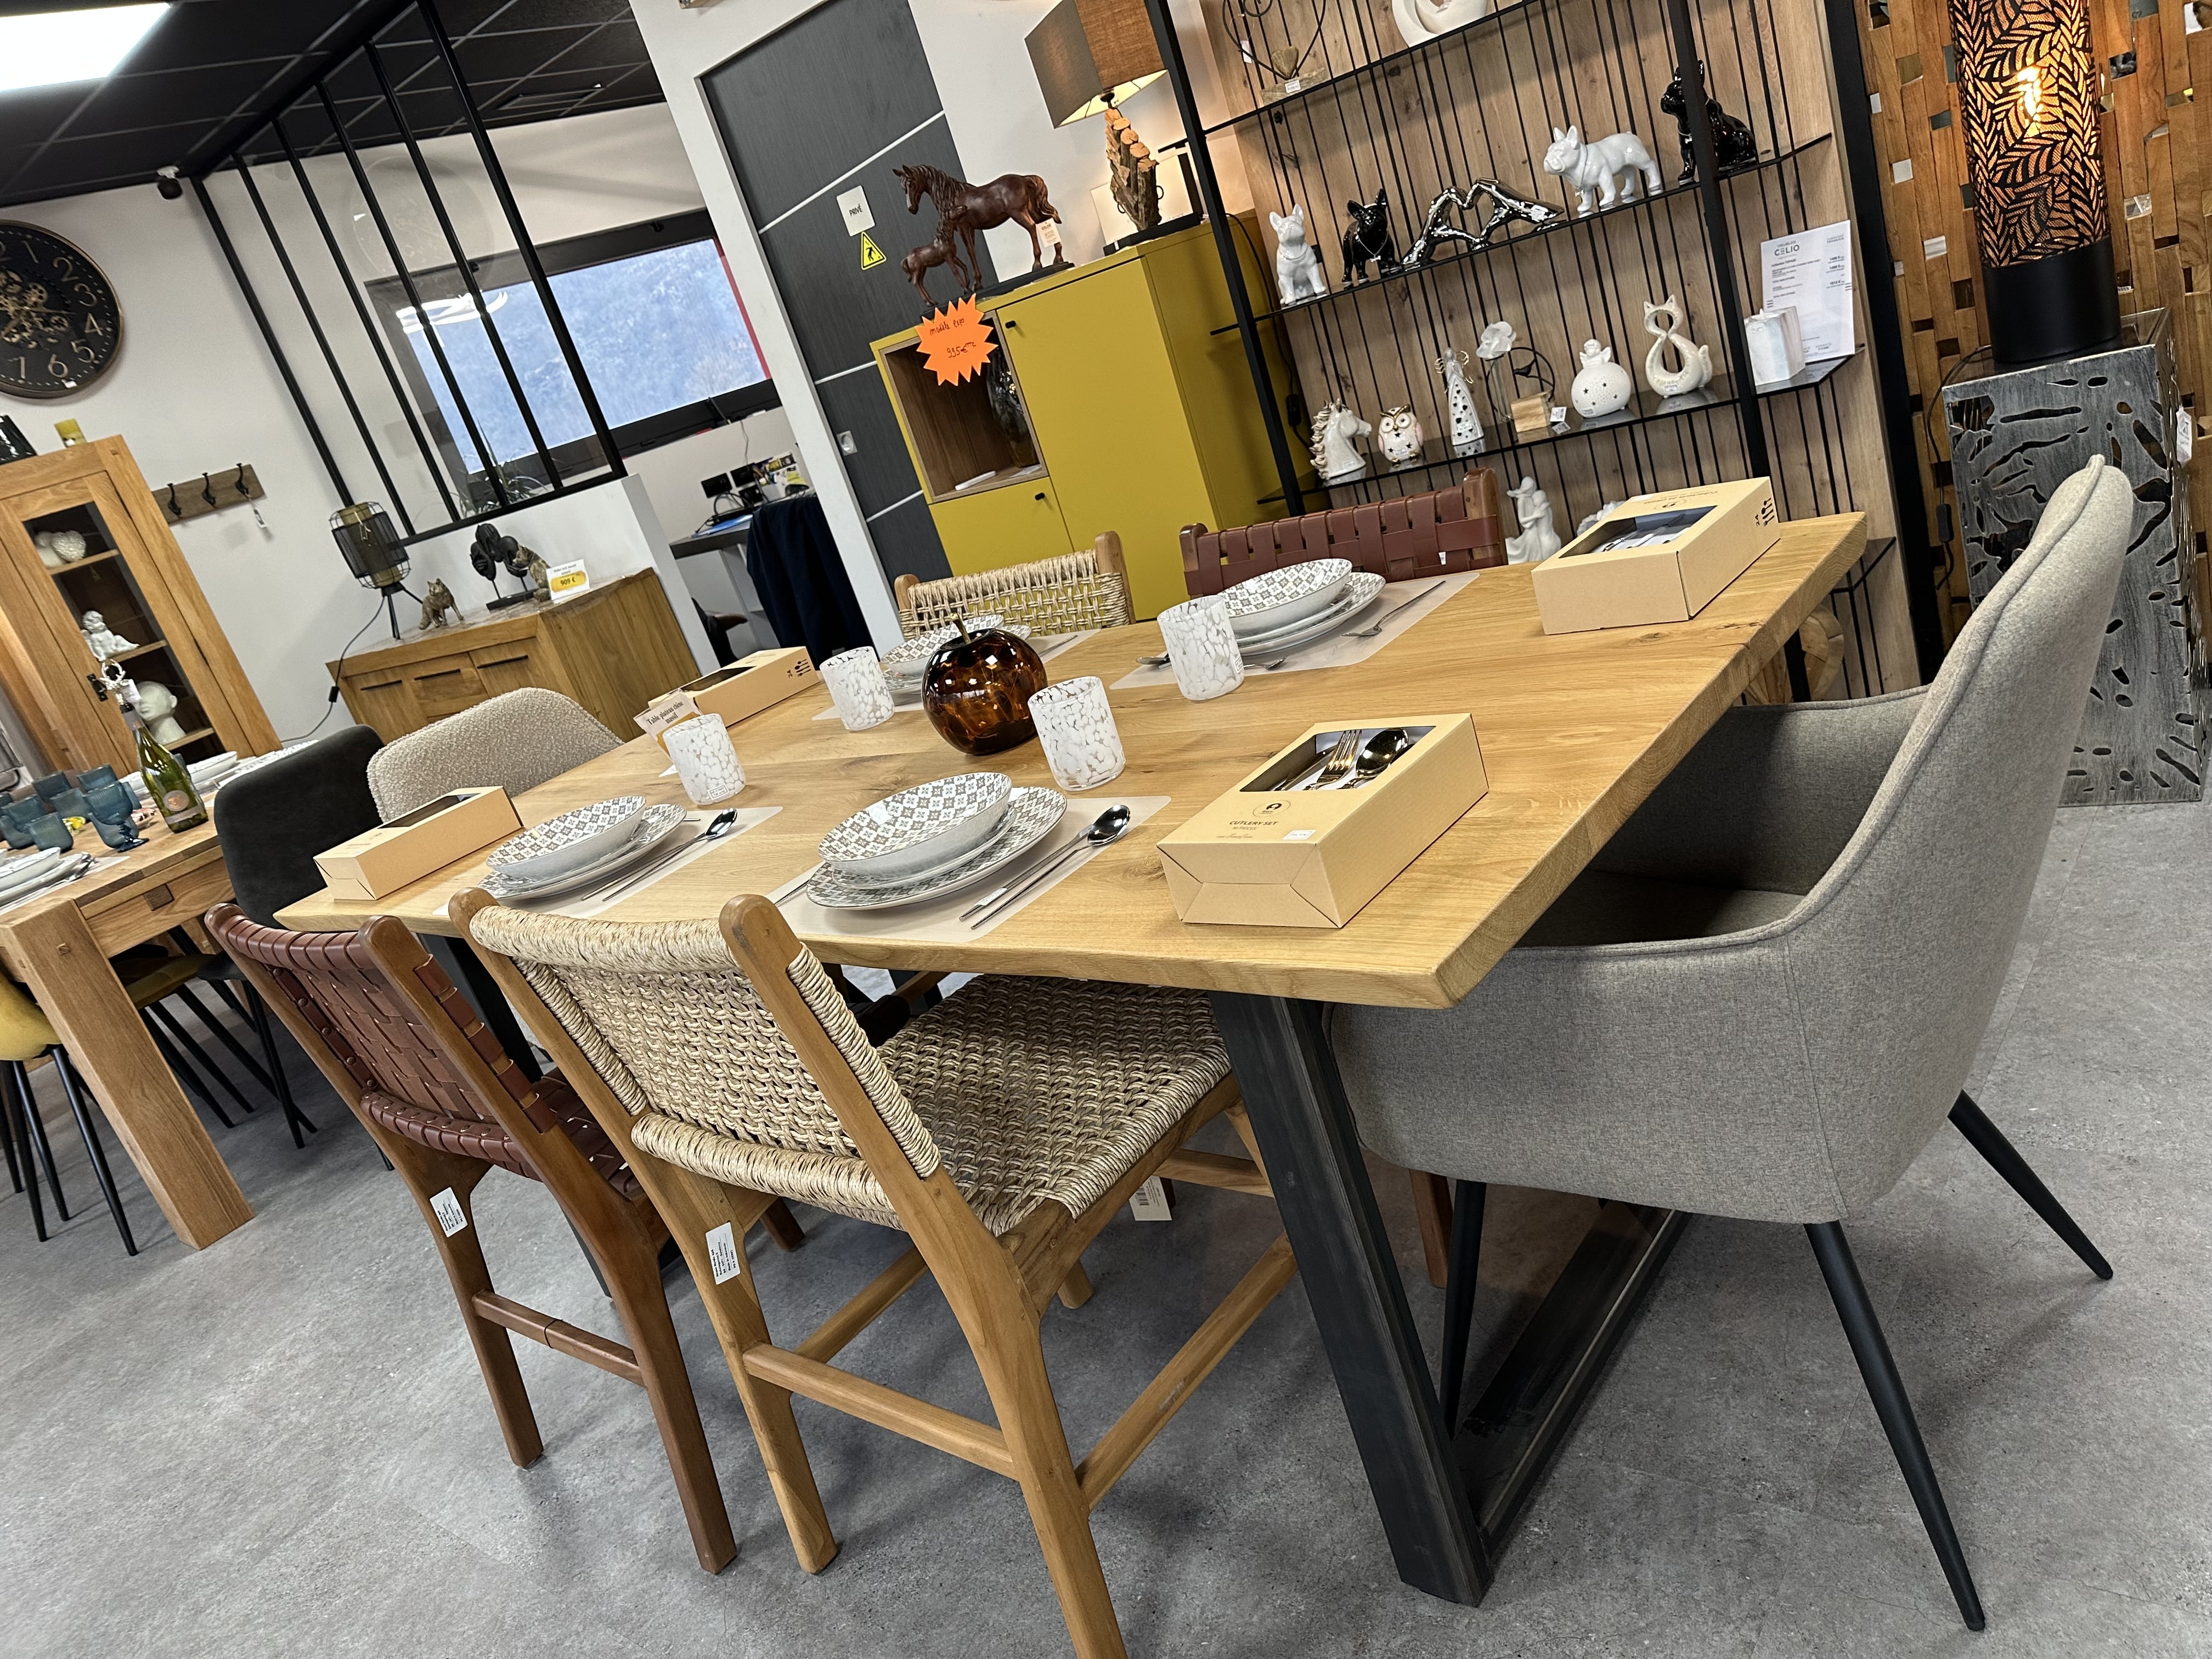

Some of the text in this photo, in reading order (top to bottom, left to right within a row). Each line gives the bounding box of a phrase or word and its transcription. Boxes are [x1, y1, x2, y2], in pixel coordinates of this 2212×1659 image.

[849, 204, 862, 217] PRIVÉ
[21, 240, 39, 263] 1
[53, 257, 80, 282] 2
[74, 283, 97, 307] 3
[85, 312, 103, 336] 4
[71, 339, 95, 363] 5
[48, 354, 69, 378] 6
[1755, 513, 1760, 527] 24
[560, 578, 571, 586] 909
[787, 669, 793, 678] 24
[646, 701, 684, 725] Table plateau chêne
[665, 712, 679, 724] massif
